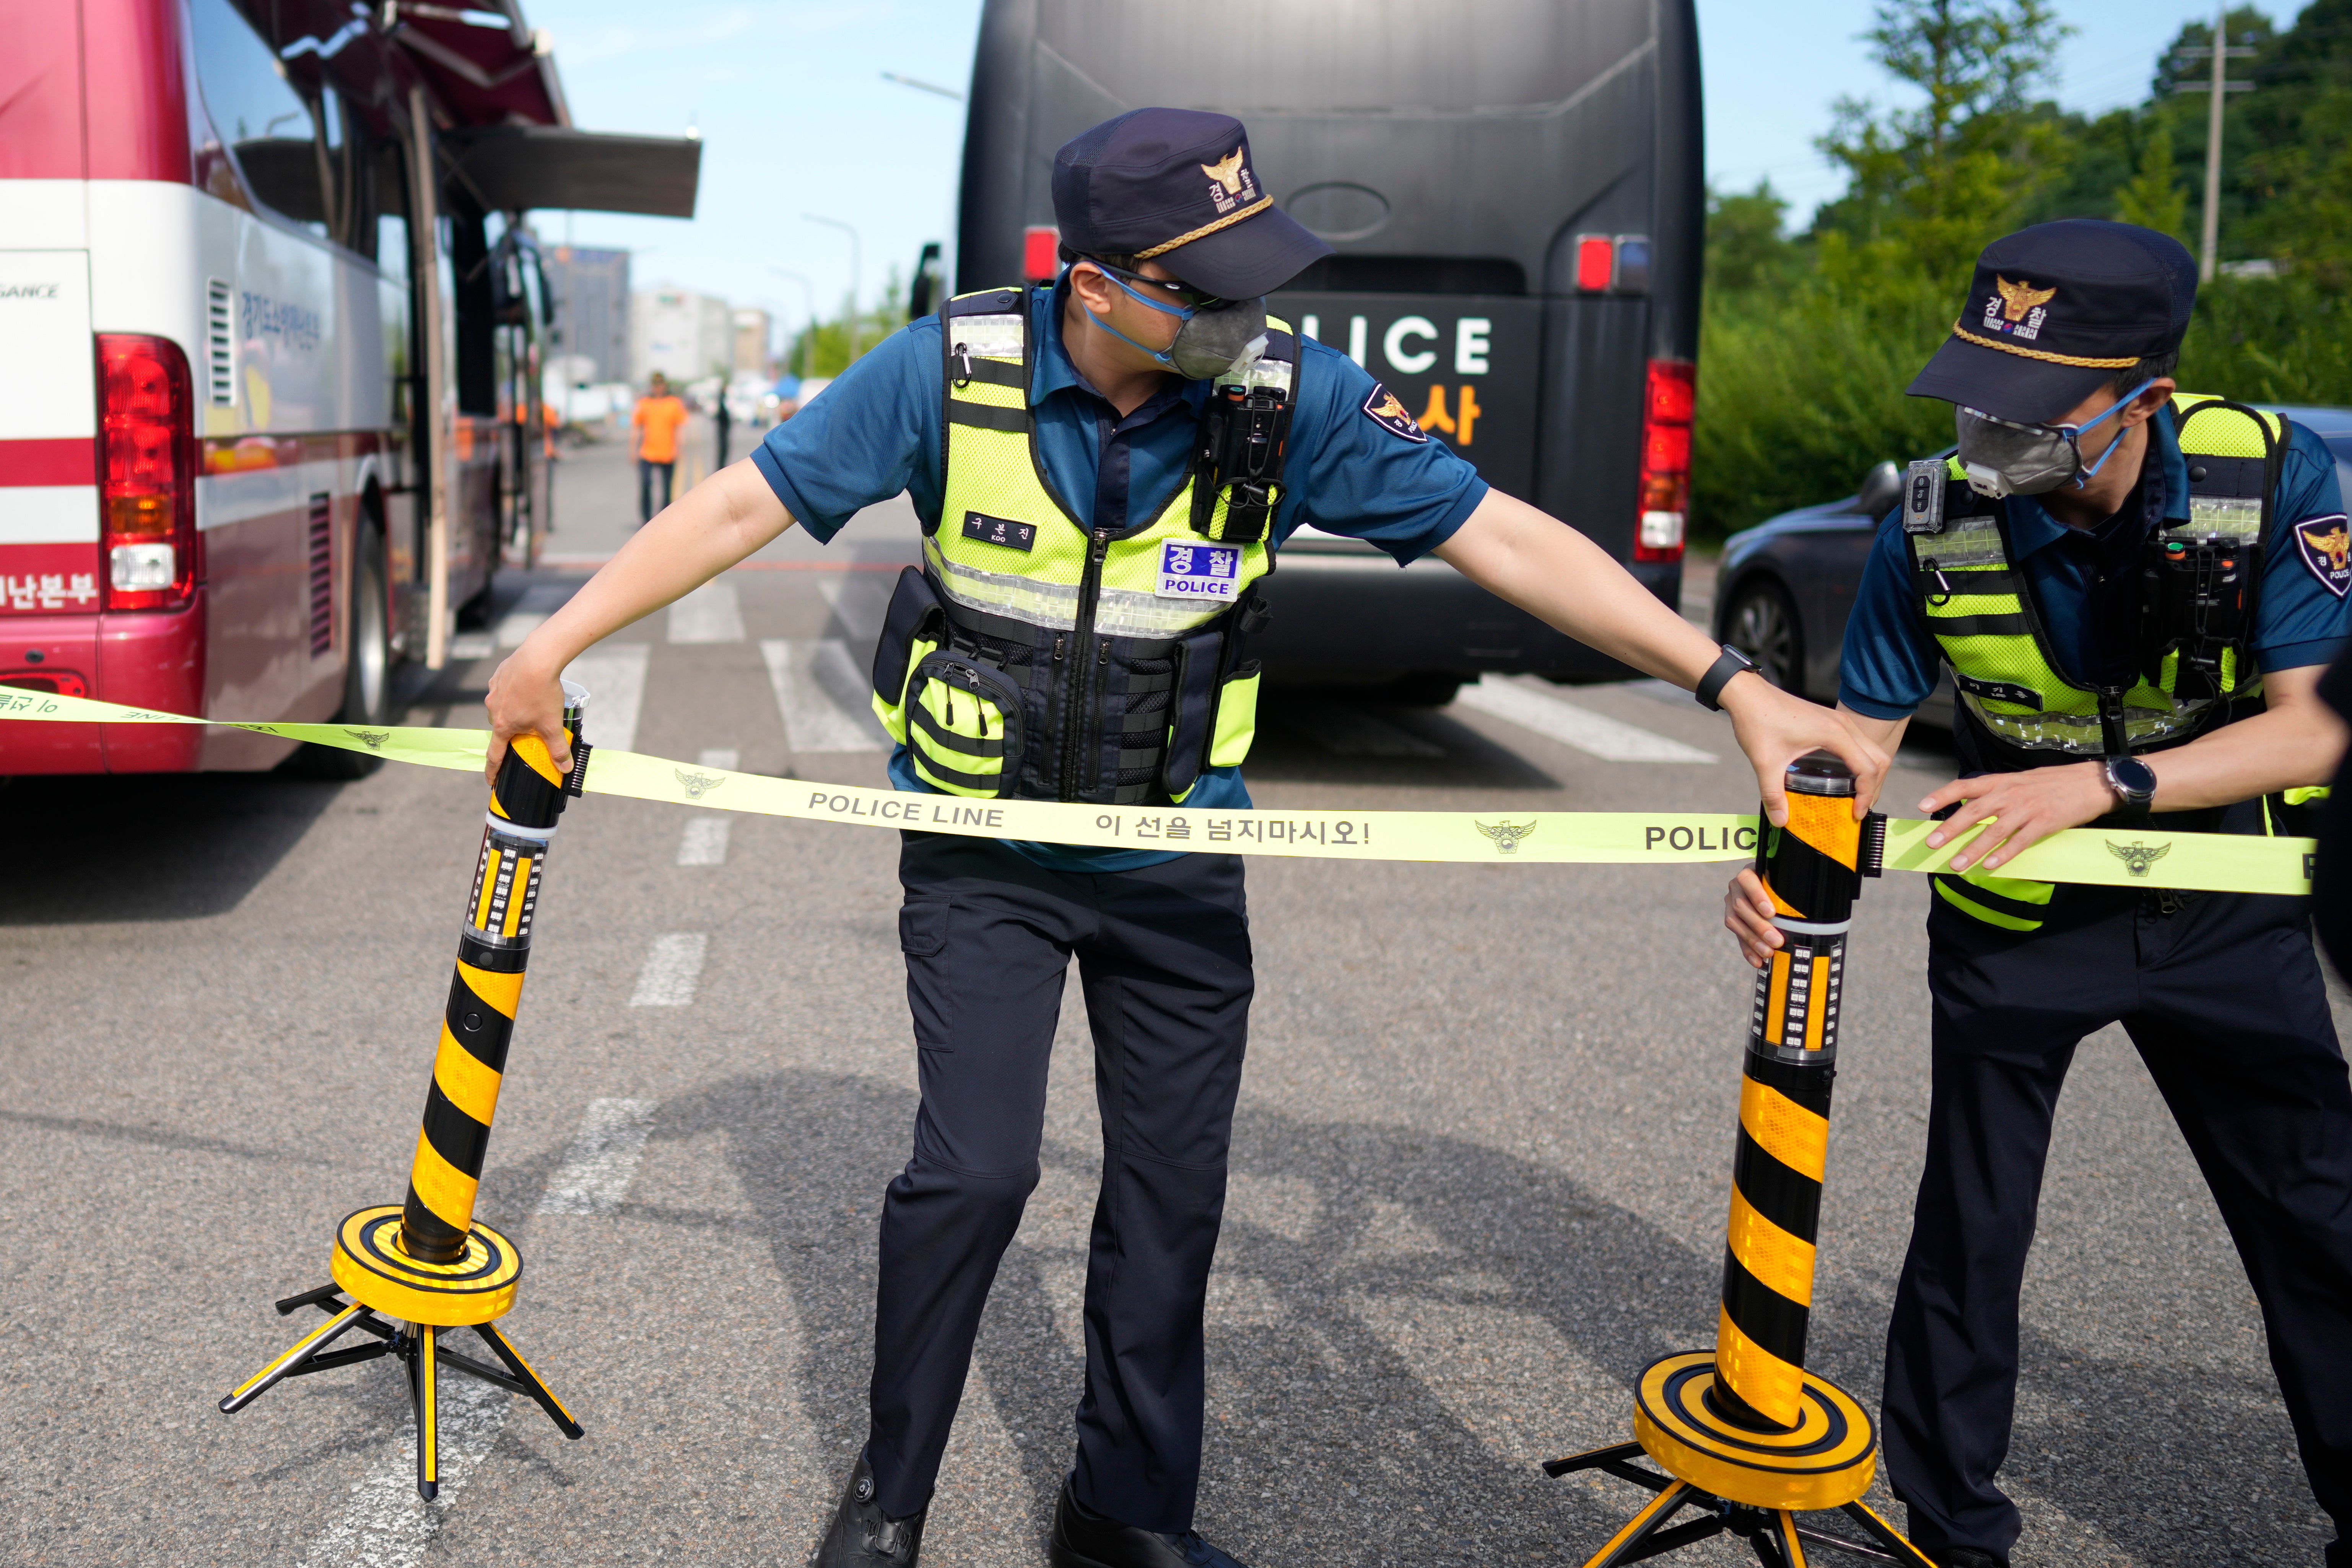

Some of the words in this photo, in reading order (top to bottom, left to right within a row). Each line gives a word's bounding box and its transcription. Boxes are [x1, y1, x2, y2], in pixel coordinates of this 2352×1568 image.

[1209, 182, 1224, 203] 경
[1986, 296, 2002, 317] 경
[2028, 307, 2047, 329] 찰
[1165, 579, 1229, 594] POLICE
[2330, 569, 2349, 580] POLICE
[0, 574, 97, 609] 난본부
[808, 792, 922, 821] POLICE
[932, 805, 1004, 828] LINE
[1096, 815, 1121, 836] 이
[1135, 817, 1191, 839] 선을
[1207, 819, 1369, 845] 넘지마시오!
